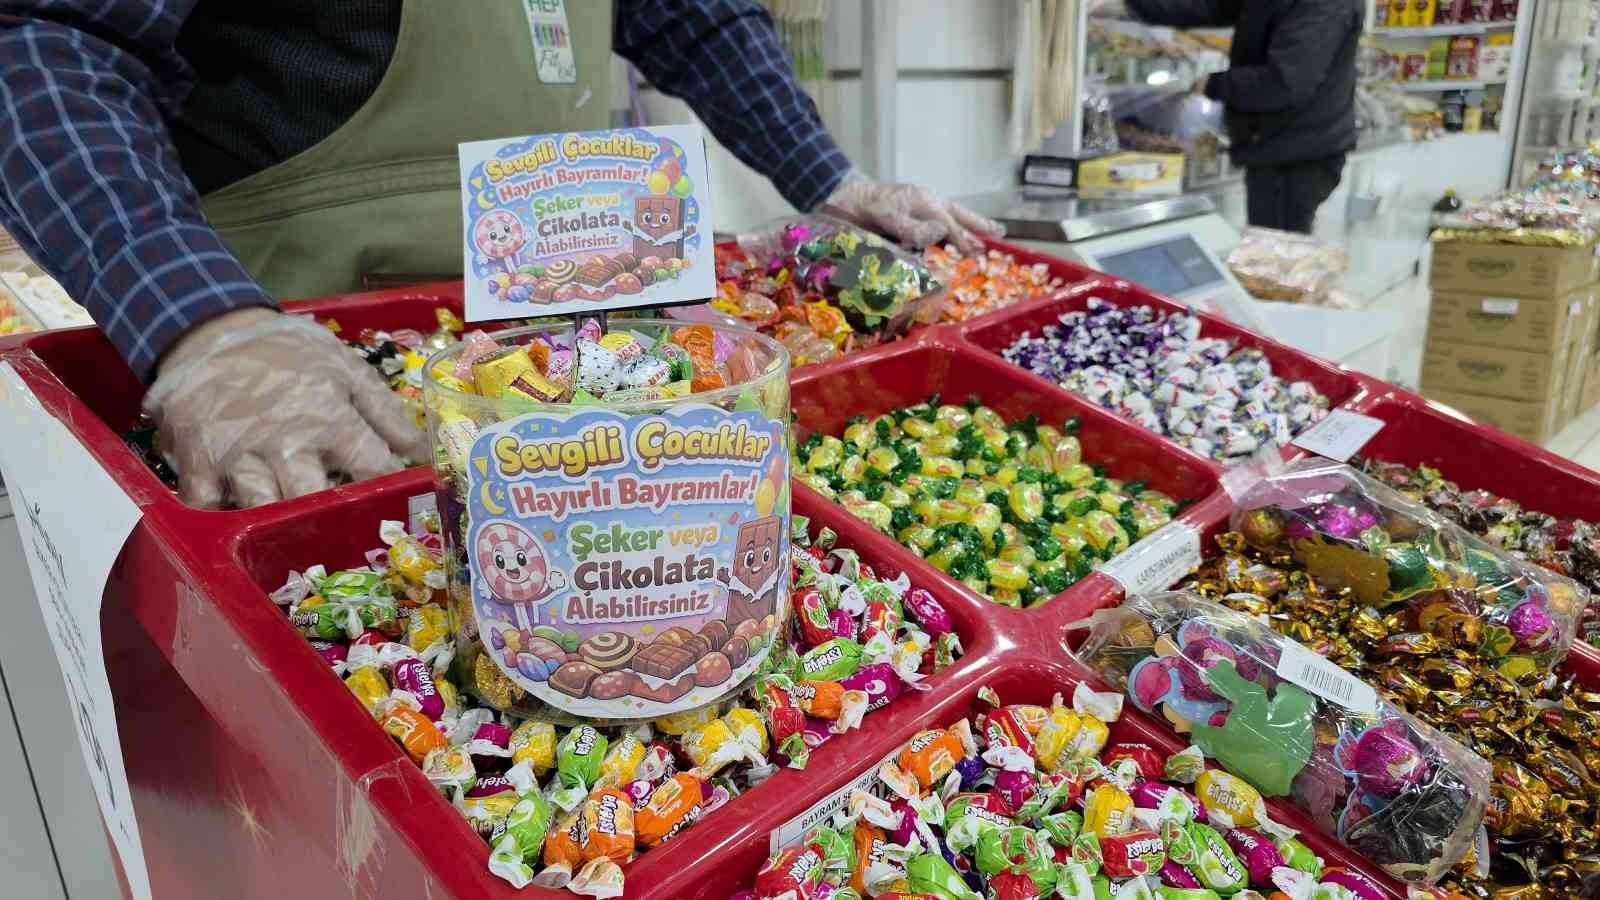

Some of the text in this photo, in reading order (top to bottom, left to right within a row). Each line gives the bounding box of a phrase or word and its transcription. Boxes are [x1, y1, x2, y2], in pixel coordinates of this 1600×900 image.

[485, 135, 657, 183] Sevgili Çocuklar
[499, 167, 648, 202] Hayırlı Bayramlar!
[533, 194, 620, 219] Şeker veya
[538, 211, 620, 241] Çikolata
[535, 233, 619, 256] Alabilirsiniz
[495, 421, 770, 477] Sevgili Çocuklar
[511, 474, 757, 519] Hayırlı Bayramlar!
[569, 524, 718, 561] Şeker veya
[573, 555, 716, 597] Çikolata
[566, 591, 710, 621] Alabilirsiniz
[801, 797, 842, 829] BAYRAM
